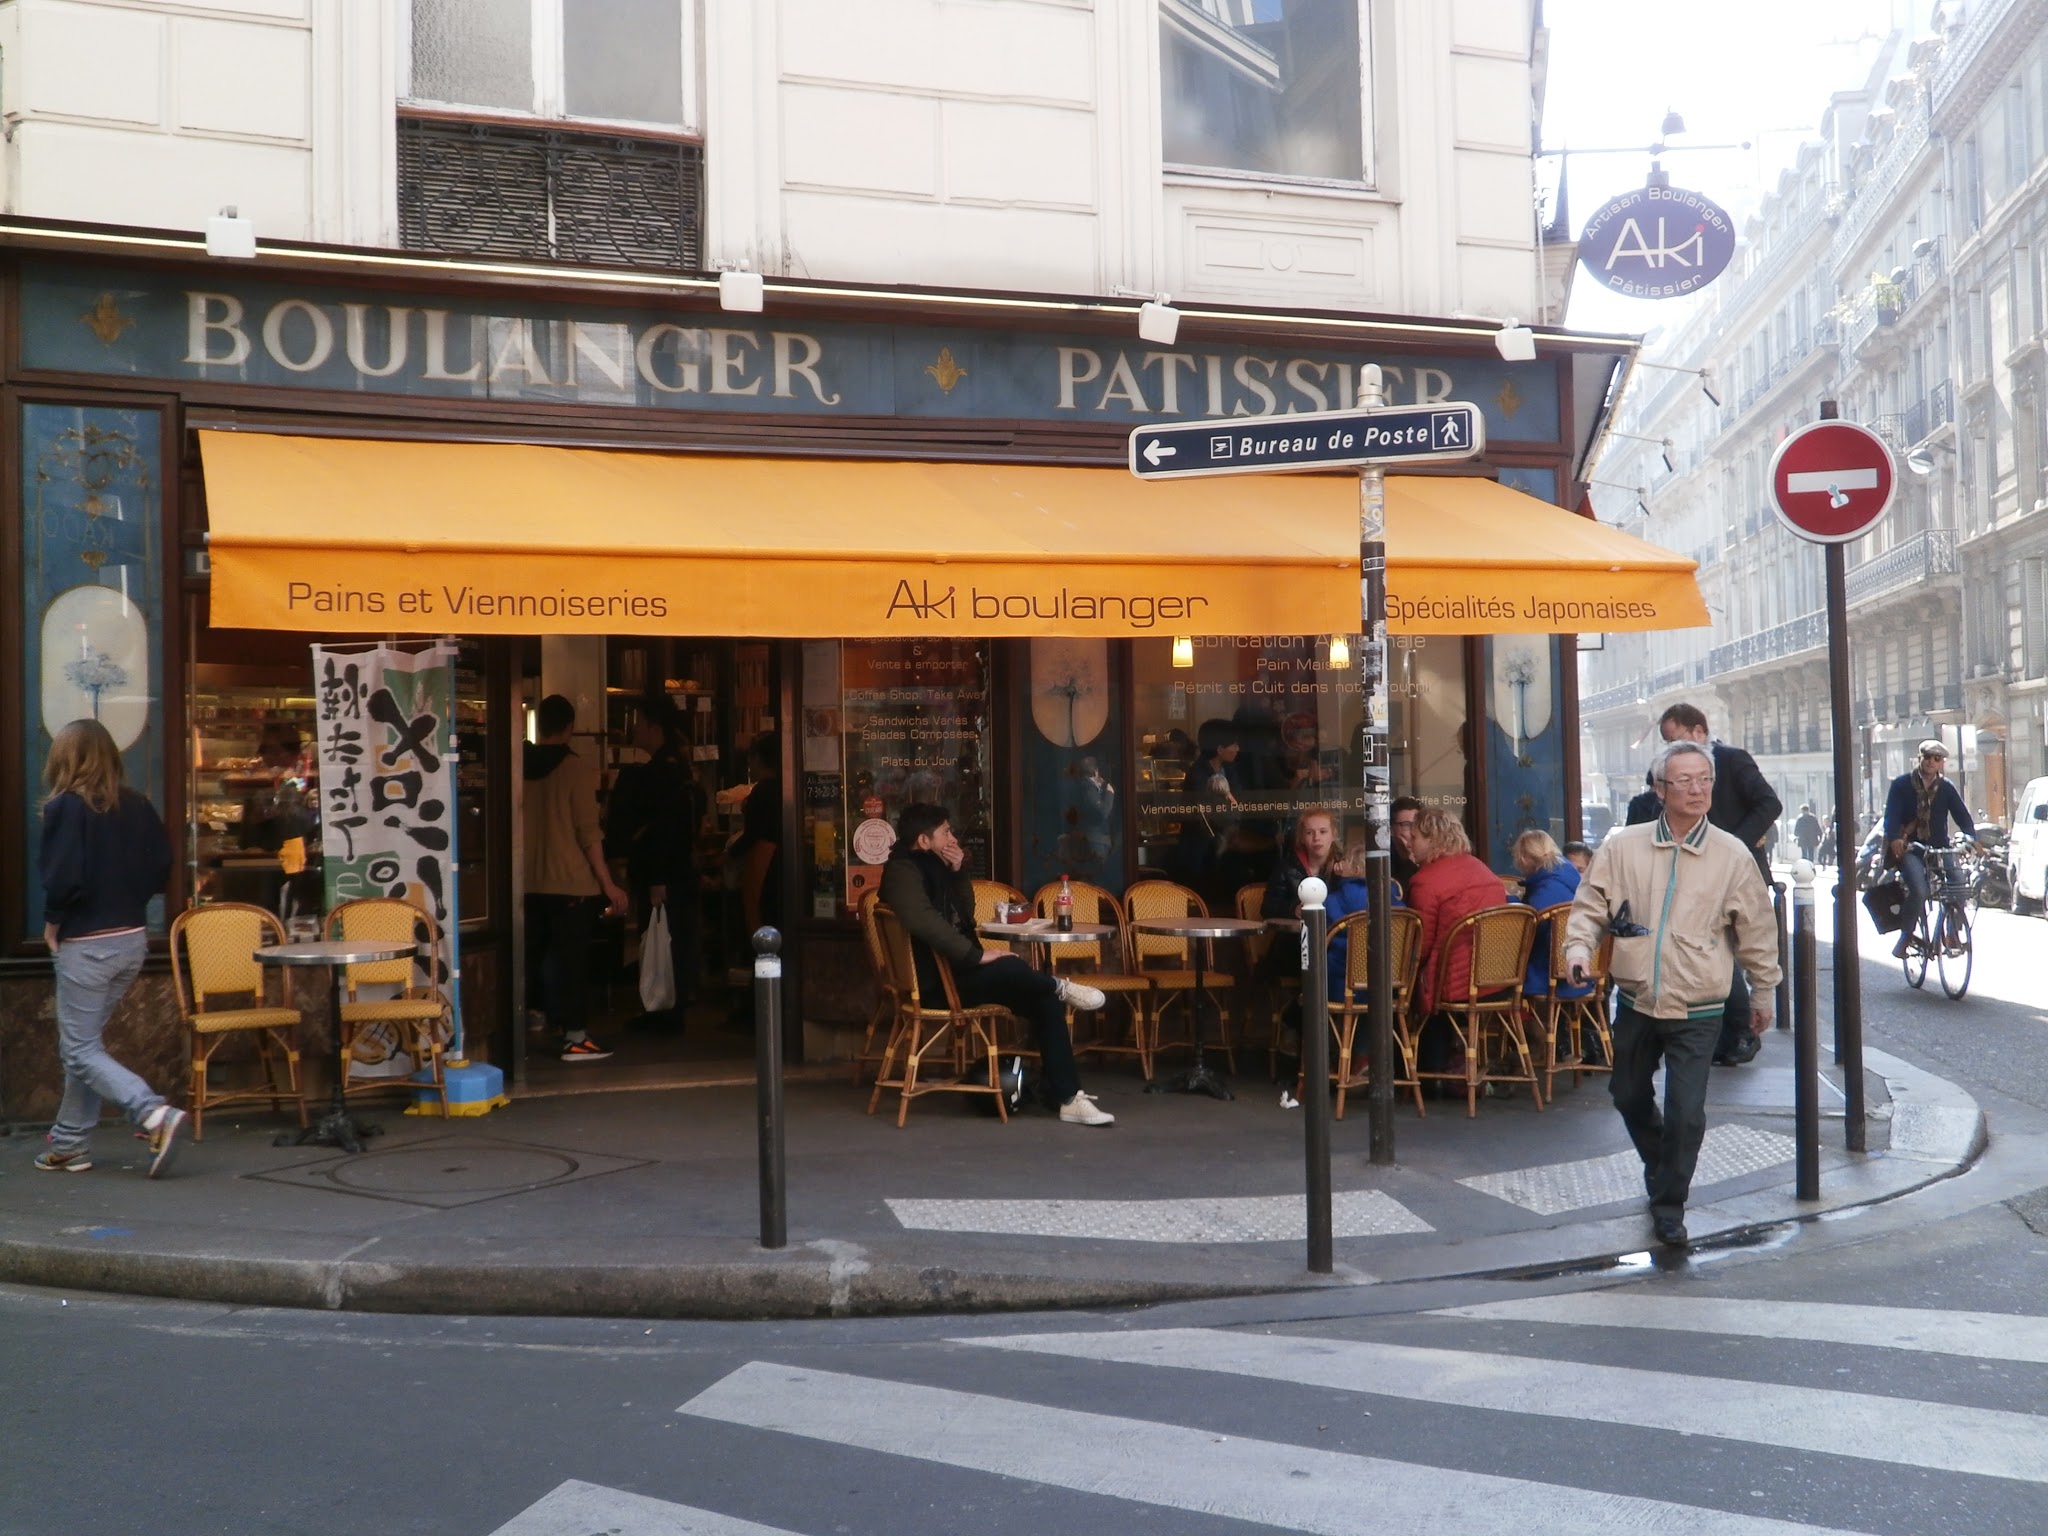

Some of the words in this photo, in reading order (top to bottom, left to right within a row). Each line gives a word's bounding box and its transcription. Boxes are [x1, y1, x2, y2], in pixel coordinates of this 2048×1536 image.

[1585, 192, 1642, 241] Artisan
[1648, 187, 1728, 234] Boulanger
[1604, 216, 1705, 270] Aki
[1608, 273, 1702, 296] Pâtissier
[180, 290, 840, 405] BOULANGER
[1239, 436, 1318, 457] Bureau
[1328, 431, 1354, 449] de
[1363, 426, 1429, 447] Poste
[288, 581, 385, 613] Pains
[397, 587, 434, 614] et
[442, 585, 668, 618] Viennoiseries
[885, 578, 956, 619] Aki
[972, 586, 1209, 629] boulanger
[1385, 594, 1516, 626] Spécialités
[1523, 595, 1657, 625] Japonaises
[1314, 634, 1426, 649] Artisnale
[912, 645, 922, 656] &
[867, 659, 900, 670] Vente
[915, 660, 968, 671] emporter
[1256, 658, 1290, 671] Pain
[1296, 658, 1353, 671] Maison
[1173, 680, 1223, 694] Pétrit
[1228, 681, 1246, 694] et
[1251, 679, 1285, 693] Cuit
[1290, 679, 1328, 693] dans
[1335, 681, 1363, 693] not
[849, 689, 886, 701] Coffee
[927, 689, 953, 700] Take
[957, 689, 985, 701] Away
[869, 715, 929, 726] Sandwichs
[933, 715, 968, 726] Variés
[862, 729, 906, 740] Salades
[910, 729, 976, 741] Composées
[881, 756, 910, 767] Plats
[914, 757, 928, 766] du
[931, 756, 958, 767] Jour
[1140, 804, 1212, 815] Viennoiseries
[1215, 803, 1227, 813] et
[1230, 801, 1289, 812] Pâtisseries
[1443, 795, 1468, 806] Shop
